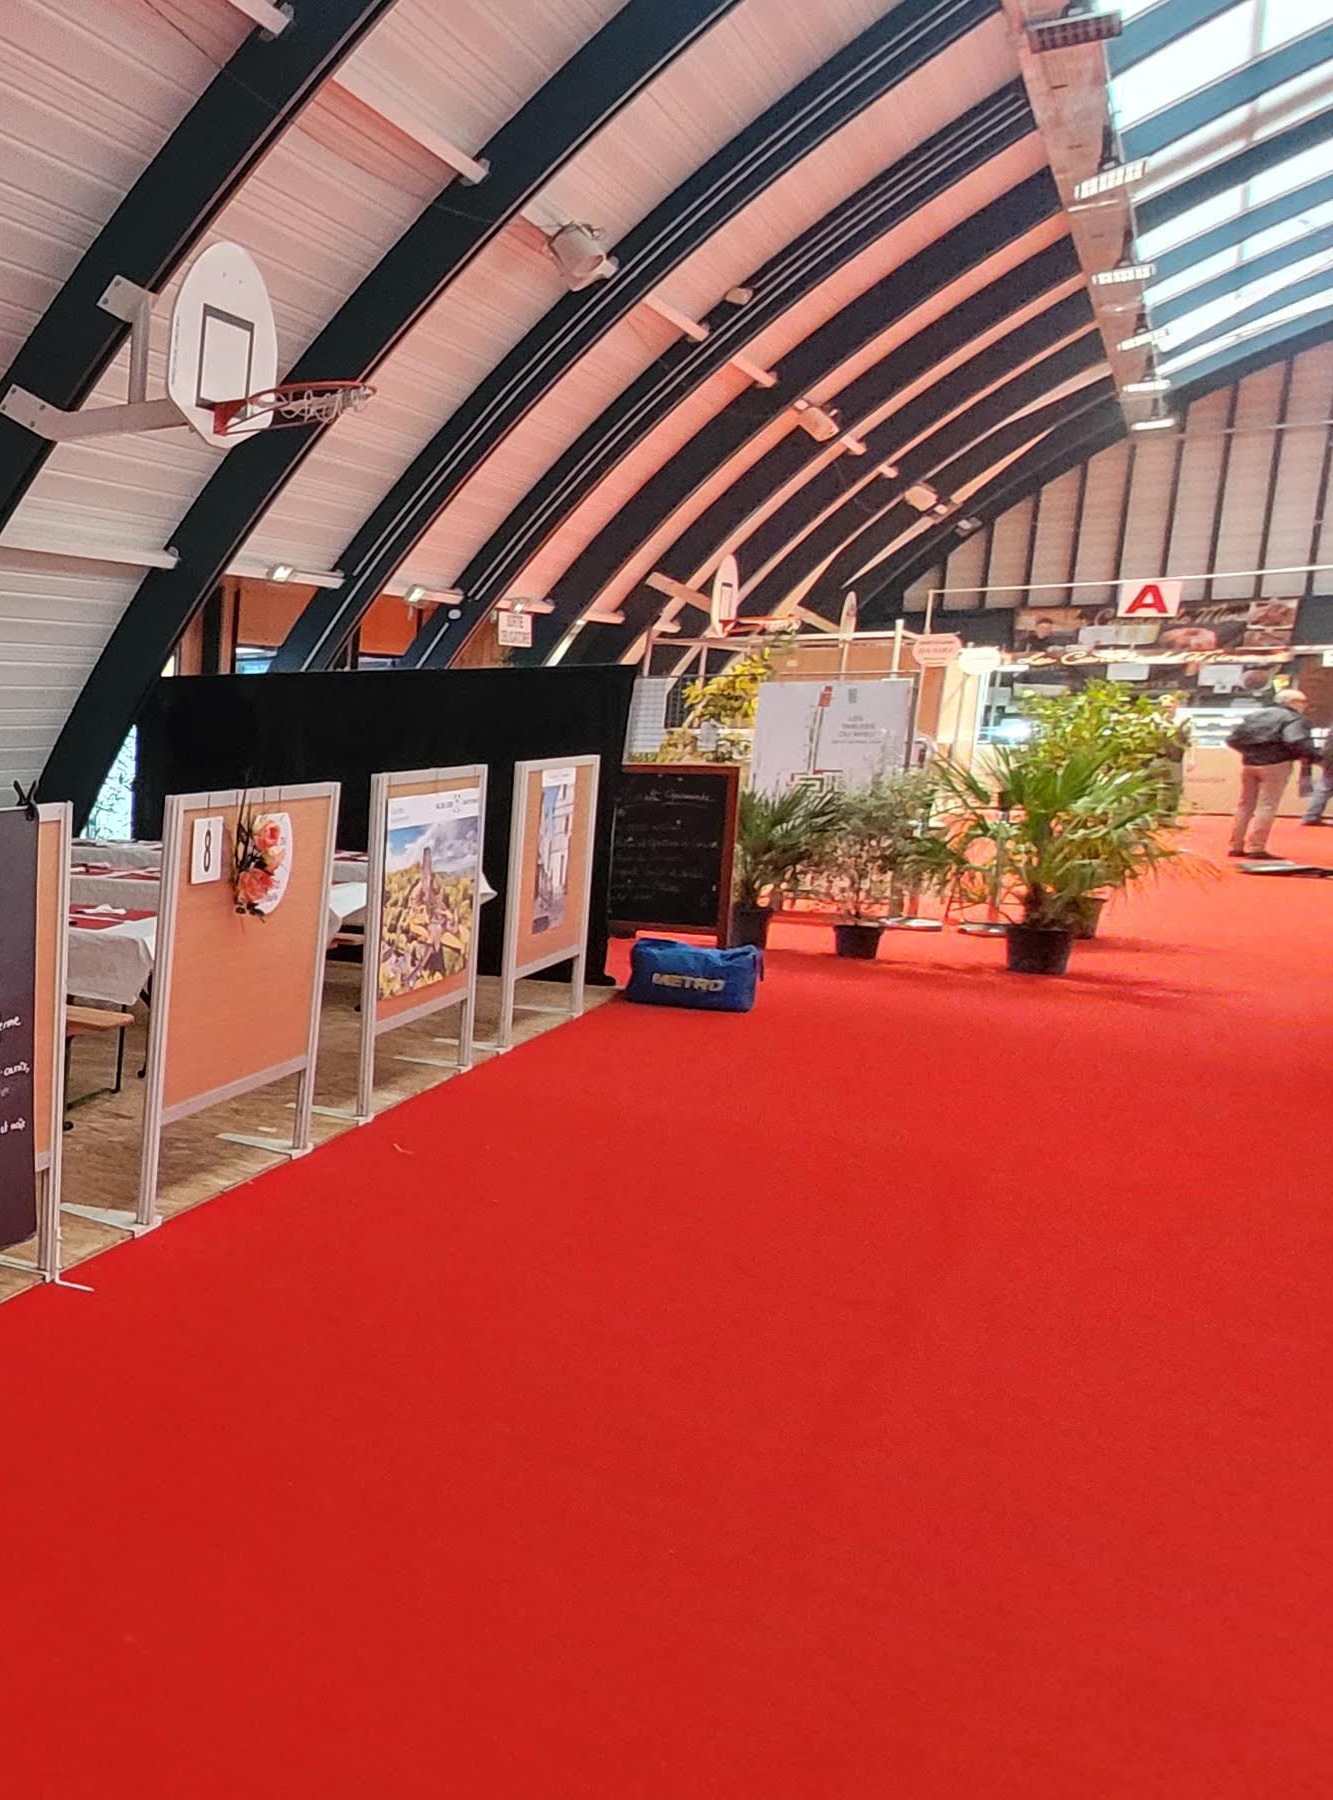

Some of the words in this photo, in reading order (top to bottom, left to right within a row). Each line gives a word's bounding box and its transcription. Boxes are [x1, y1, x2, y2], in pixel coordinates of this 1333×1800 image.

[1124, 584, 1168, 614] A
[203, 829, 212, 873] 8
[652, 972, 726, 992] METRO
